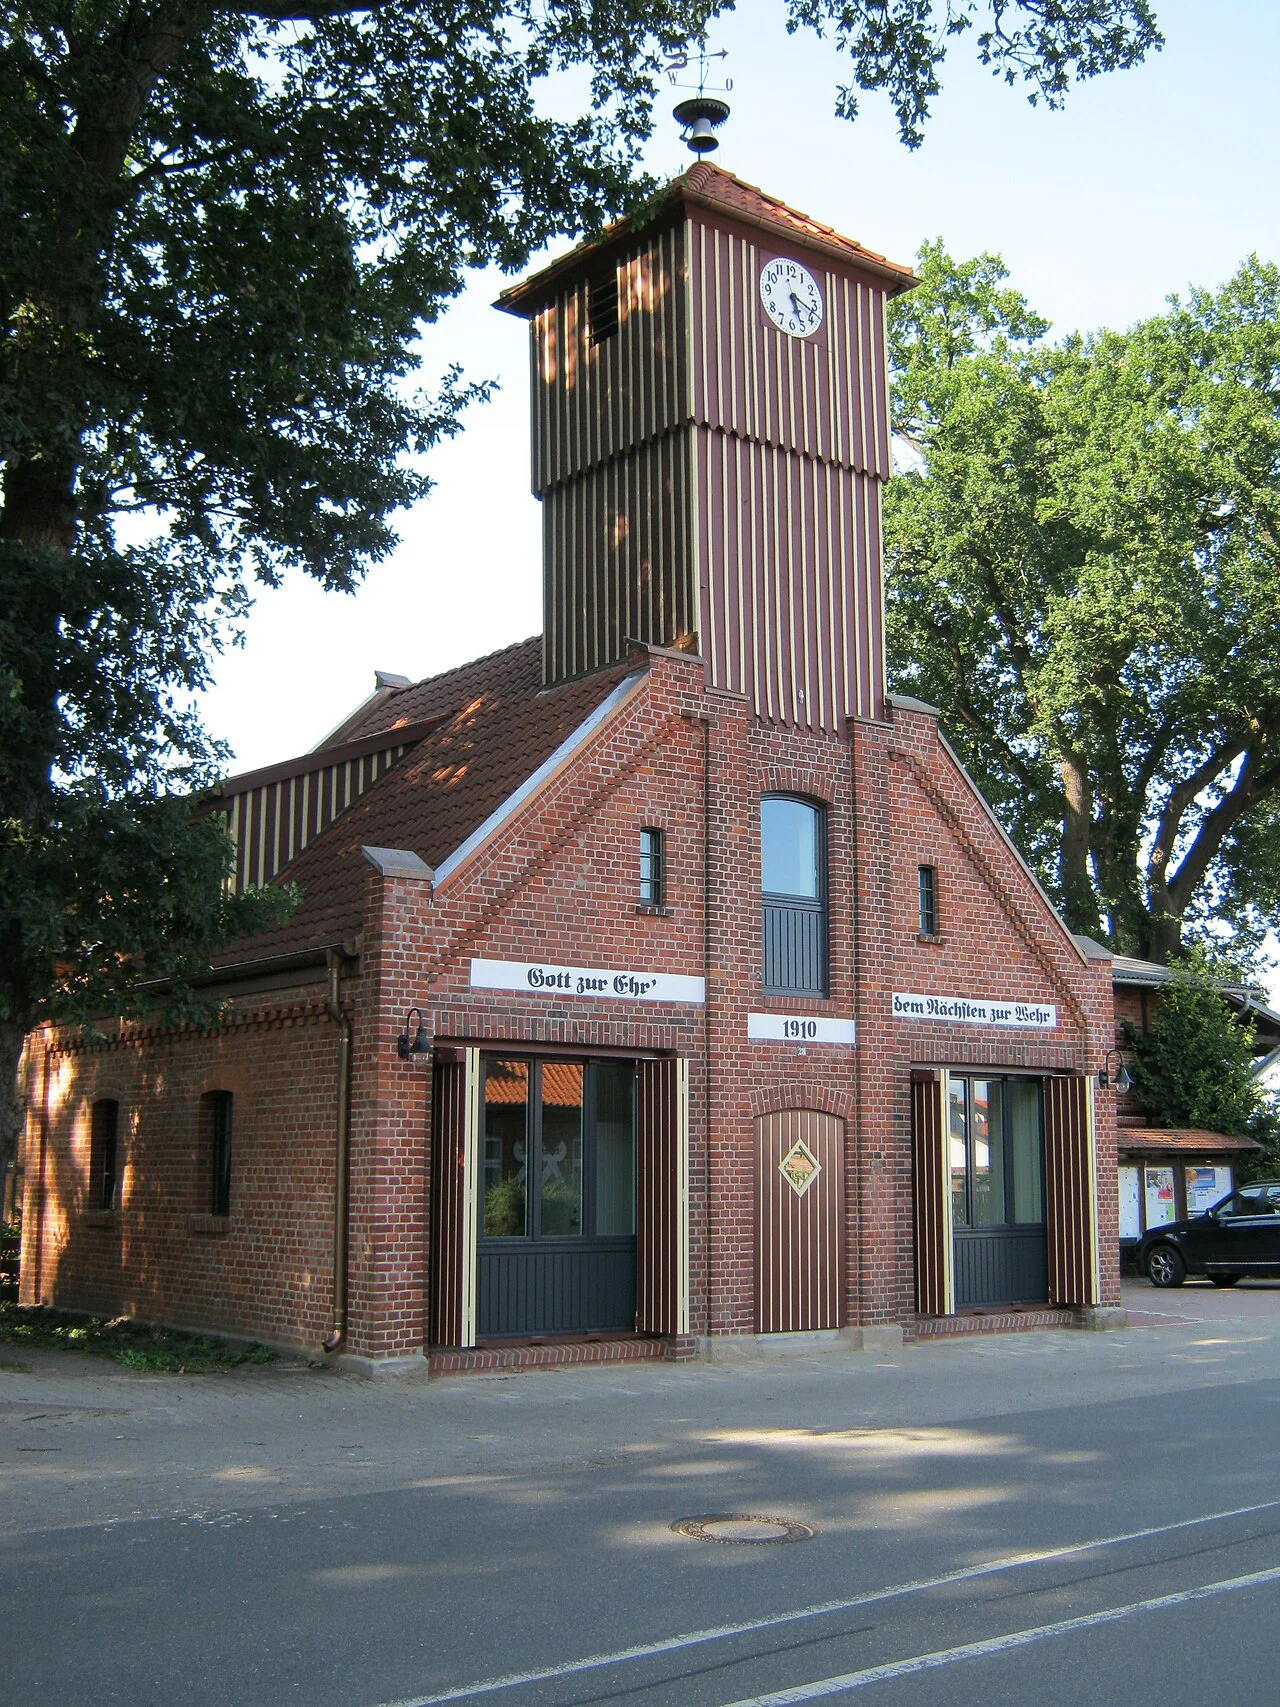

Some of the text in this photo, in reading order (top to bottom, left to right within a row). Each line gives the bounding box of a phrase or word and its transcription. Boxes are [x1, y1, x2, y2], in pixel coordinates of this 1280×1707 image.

[667, 71, 678, 85] W
[725, 78, 733, 91] O
[776, 265, 783, 275] 11
[787, 265, 796, 278] 12
[767, 271, 777, 284] 10
[800, 273, 803, 284] 1
[765, 284, 771, 296] 9
[808, 285, 814, 296] 2
[770, 301, 776, 313] 8
[812, 300, 817, 311] 3
[778, 313, 784, 325] 7
[789, 319, 795, 330] 6
[808, 312, 814, 325] 4
[800, 320, 806, 332] 5
[527, 967, 571, 989] Gott
[576, 977, 608, 994] zur
[894, 996, 924, 1014] dem
[989, 1008, 1012, 1022] zur
[1015, 1007, 1050, 1024] Wehr
[782, 1020, 817, 1039] 1910
[797, 1047, 807, 1056] 28
